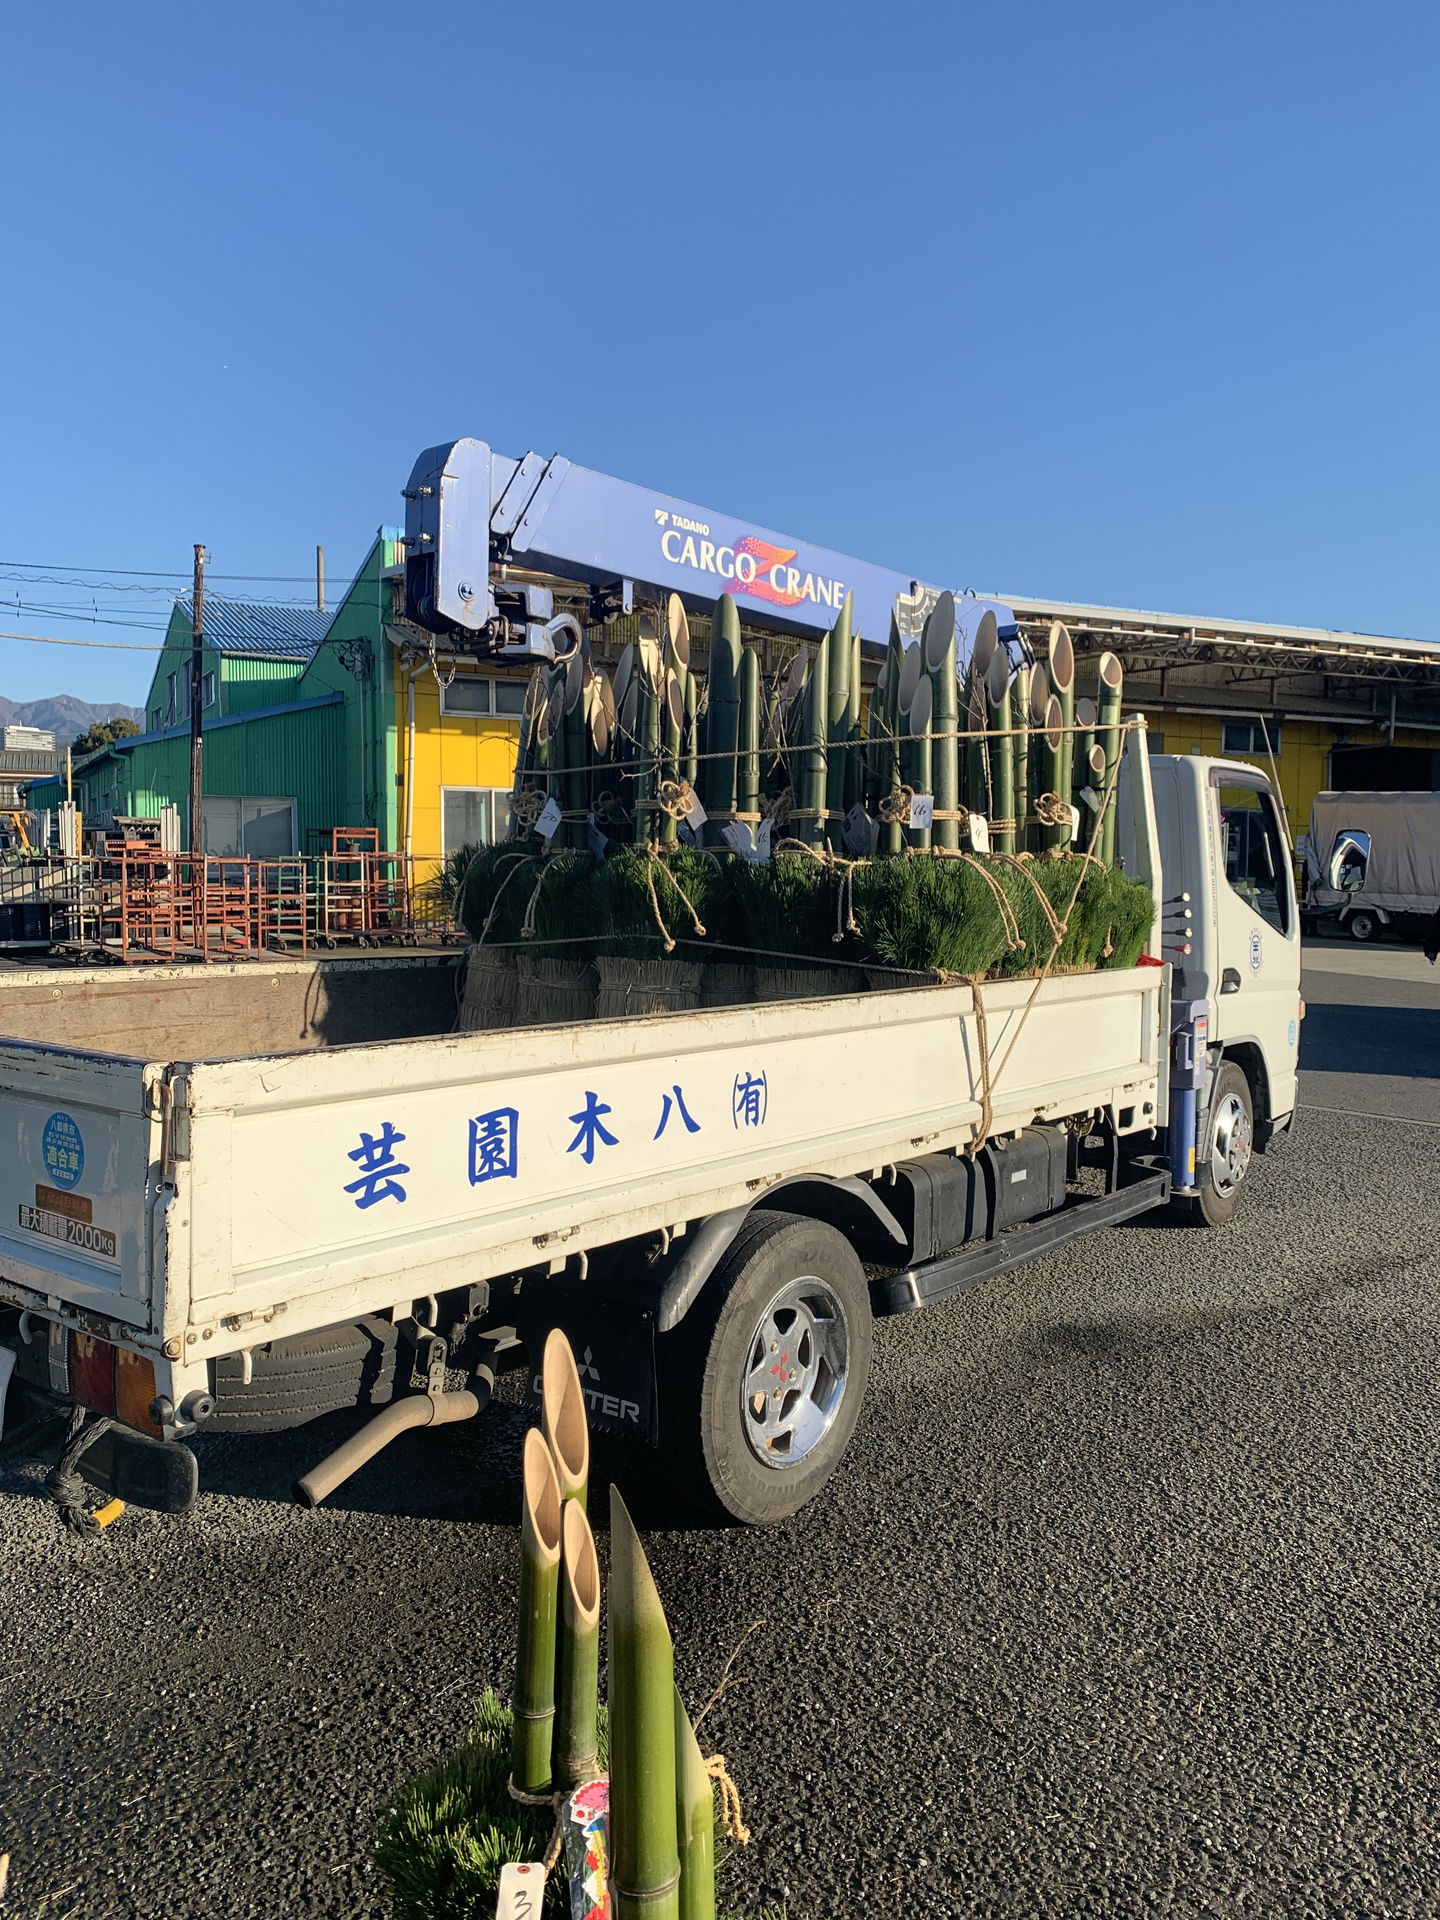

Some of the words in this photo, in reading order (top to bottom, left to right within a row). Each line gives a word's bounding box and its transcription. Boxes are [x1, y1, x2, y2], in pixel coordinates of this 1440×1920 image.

[671, 514, 710, 537] TADANO
[661, 530, 756, 584] CARGO
[769, 563, 845, 611] CRANE
[47, 1145, 79, 1171] 適合車
[533, 1374, 640, 1423] CTER
